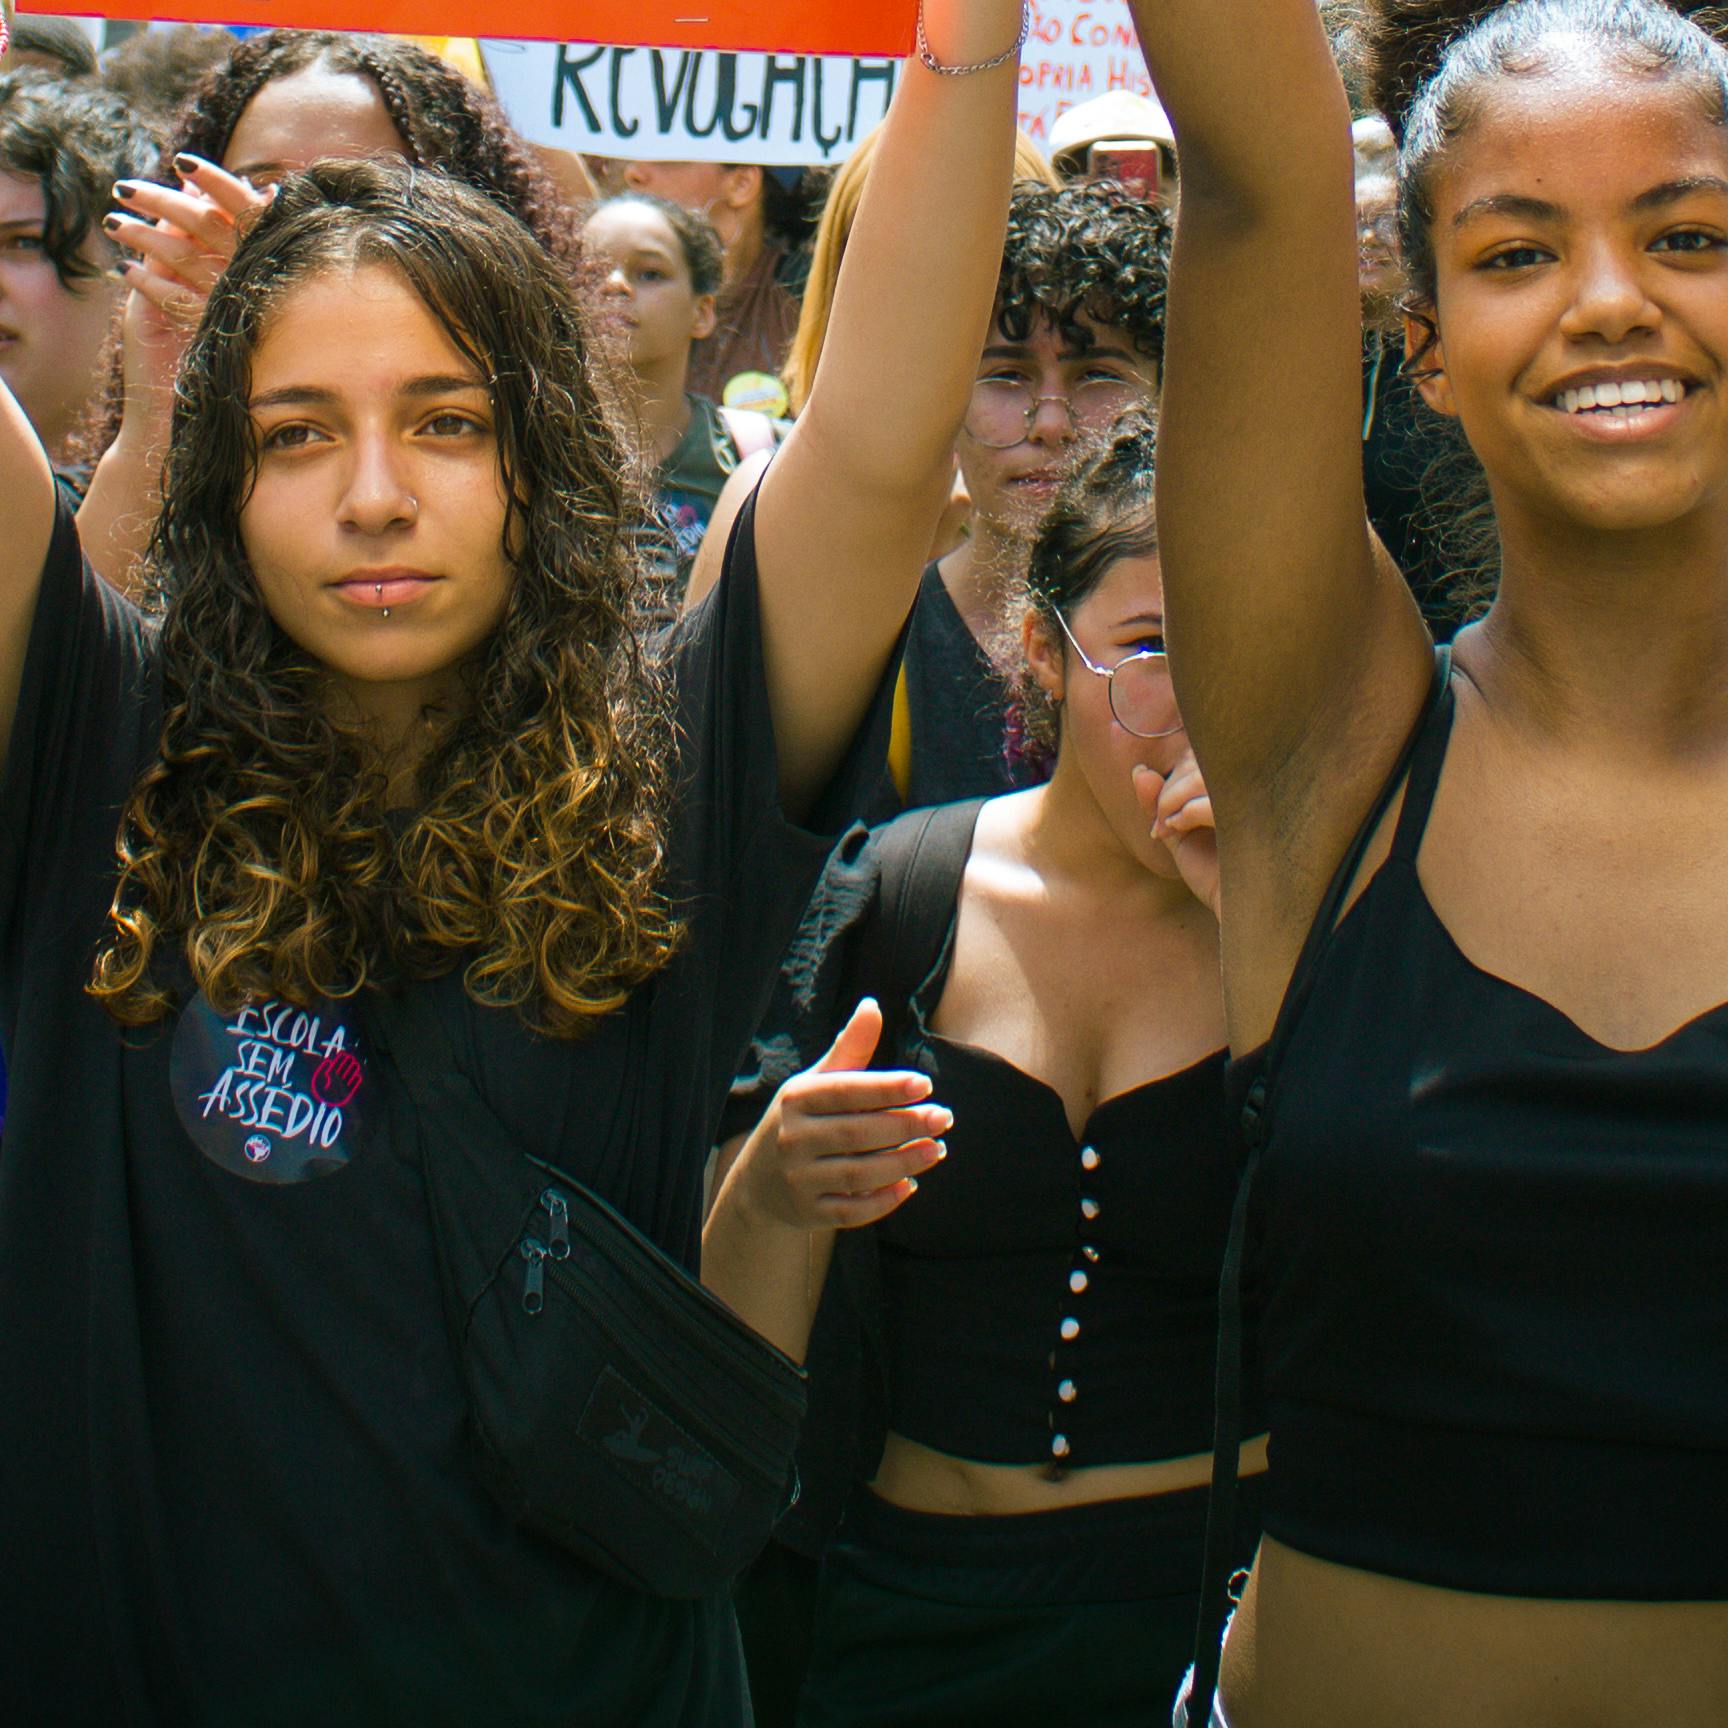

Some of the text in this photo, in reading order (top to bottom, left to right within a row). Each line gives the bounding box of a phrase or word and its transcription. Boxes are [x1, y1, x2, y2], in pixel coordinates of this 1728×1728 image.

[226, 1001, 346, 1059] ESCOLA
[232, 1038, 296, 1084] SEM
[198, 1065, 343, 1148] ASSÉDIO
